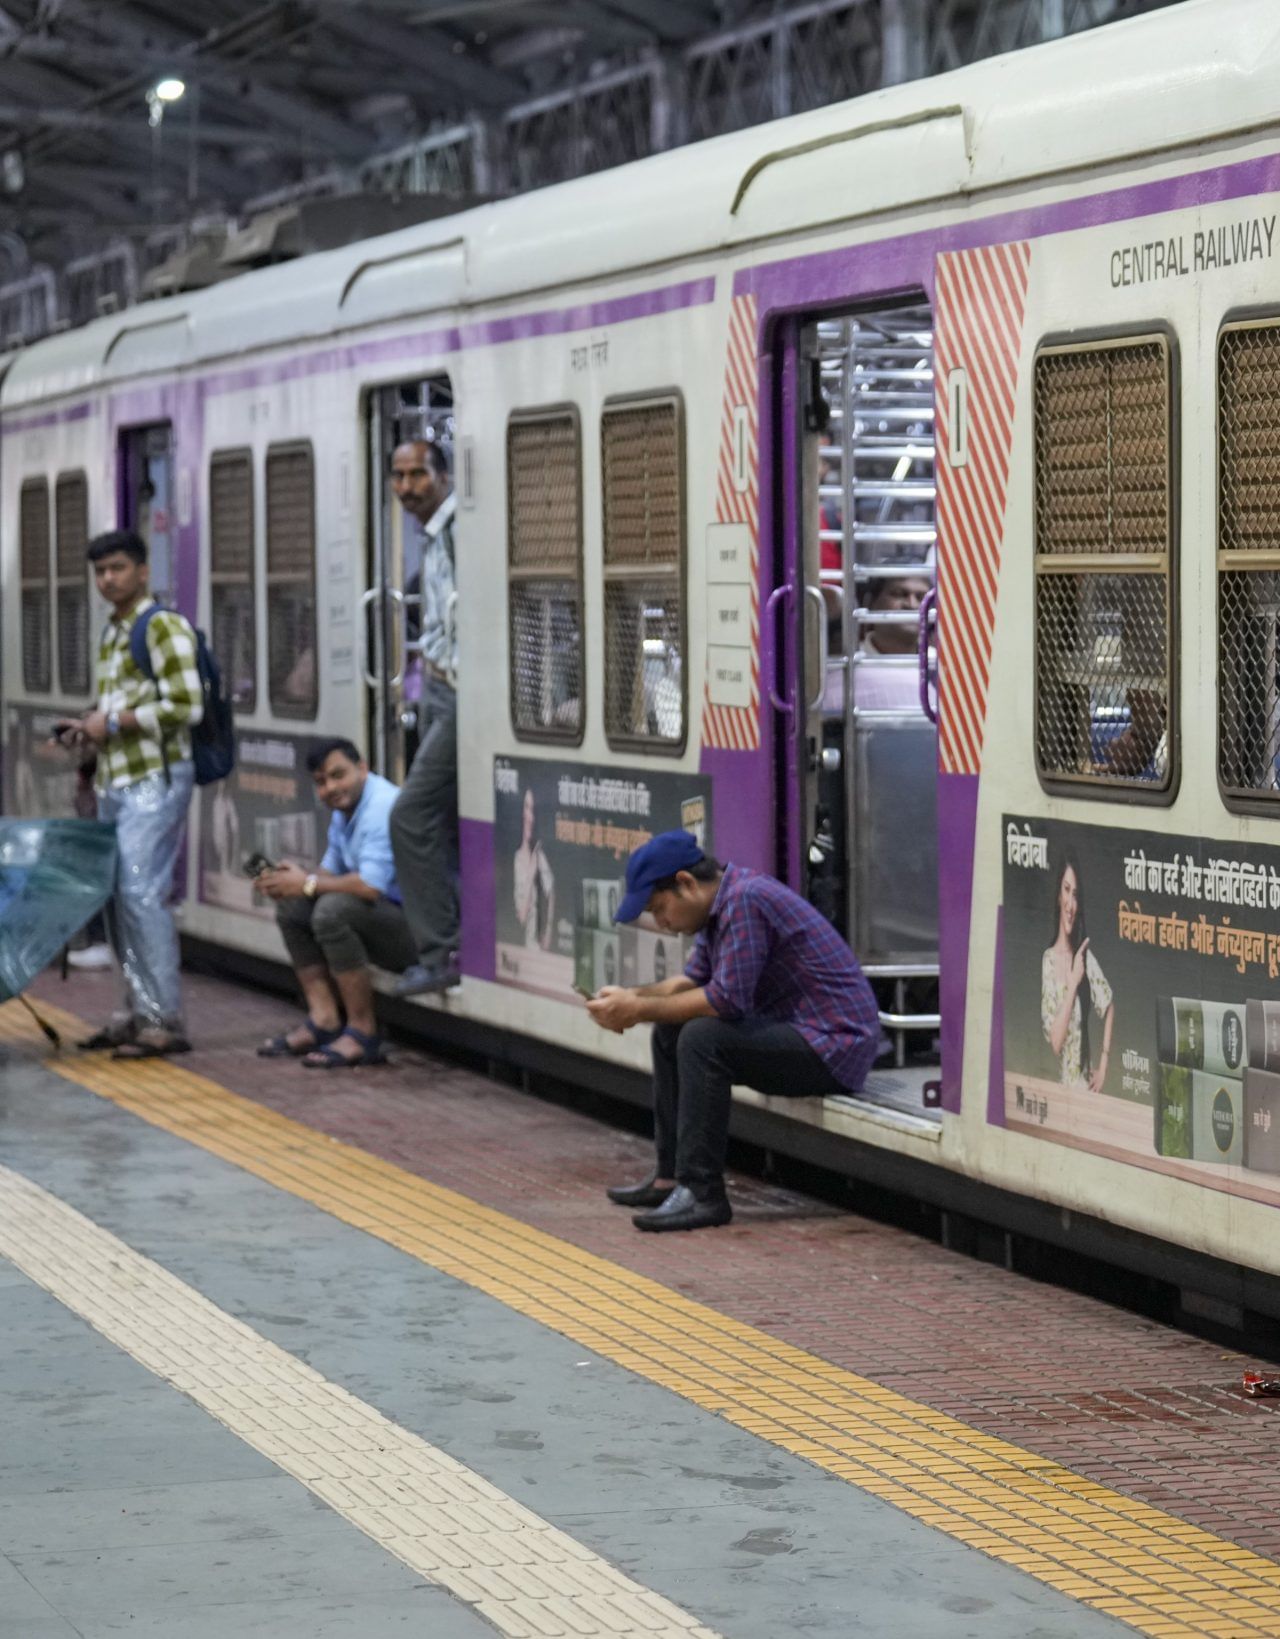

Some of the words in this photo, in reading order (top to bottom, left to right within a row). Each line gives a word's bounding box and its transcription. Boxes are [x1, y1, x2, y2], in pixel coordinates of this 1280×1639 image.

[1110, 236, 1189, 288] CENTRAL
[1194, 215, 1276, 272] RAILWAY
[1006, 822, 1048, 869] विठोबा
[1147, 859, 1162, 893] का
[1163, 853, 1179, 896] दर्द
[1180, 855, 1201, 899] और
[1118, 900, 1156, 944] विठोबा
[1158, 911, 1188, 950] हर्बल
[1191, 914, 1214, 955] और
